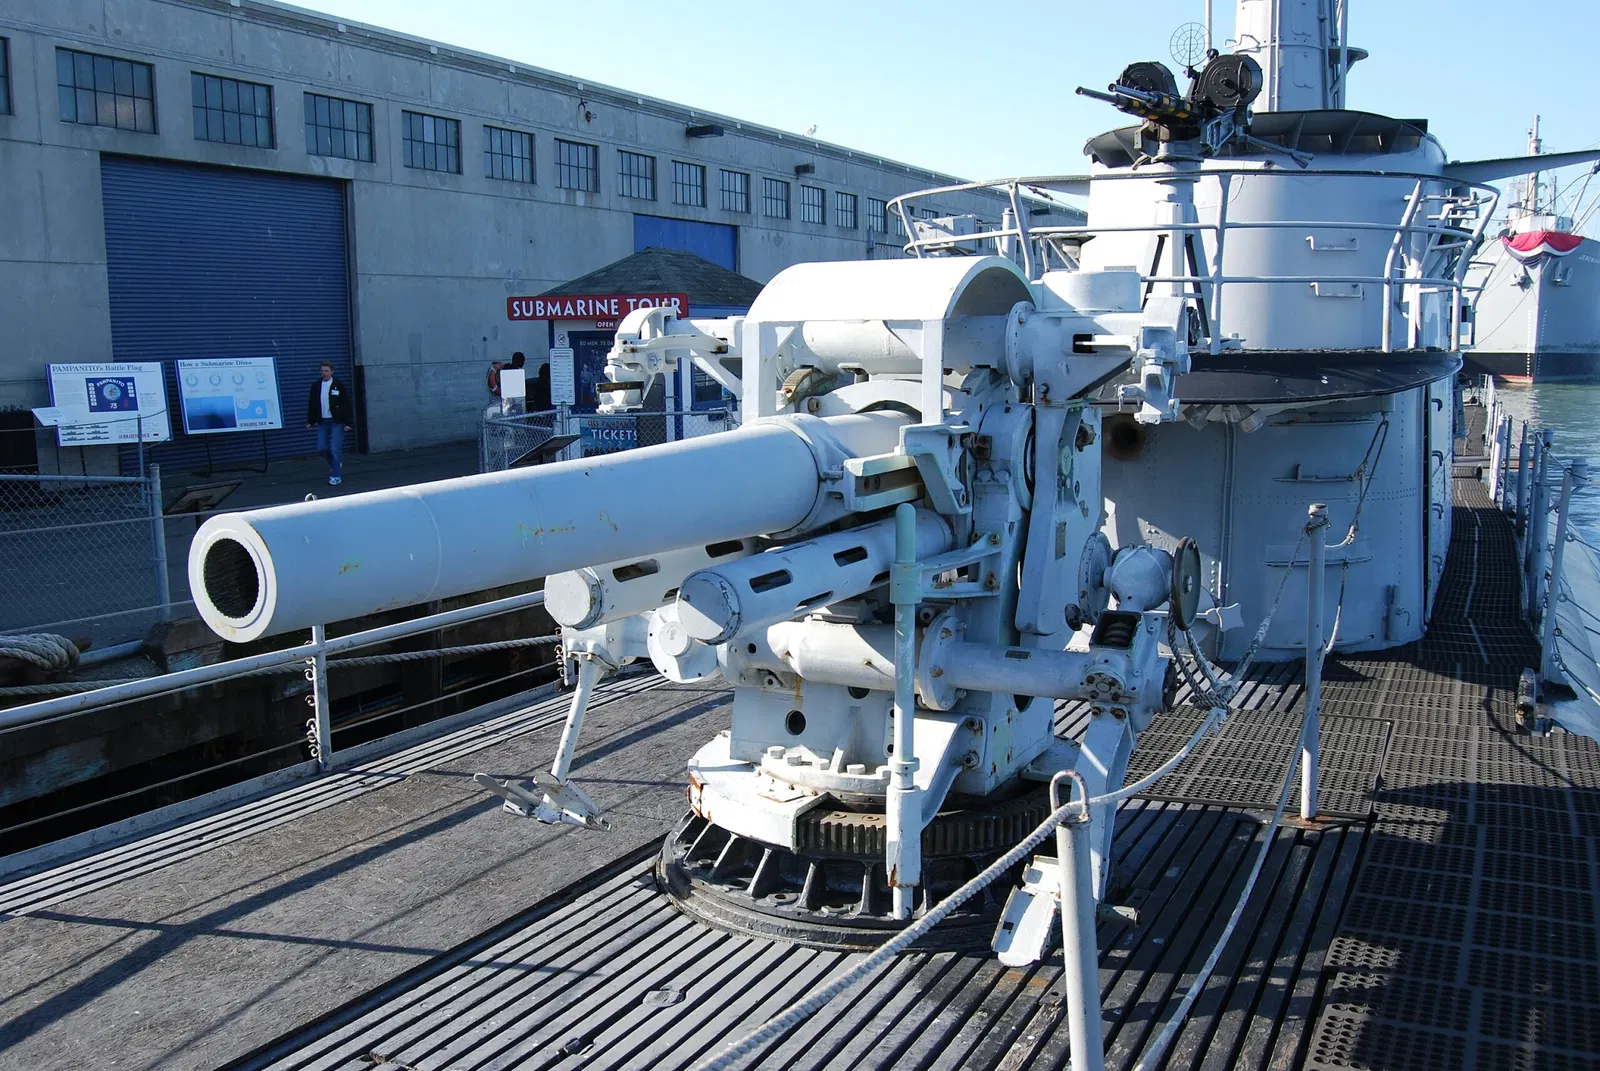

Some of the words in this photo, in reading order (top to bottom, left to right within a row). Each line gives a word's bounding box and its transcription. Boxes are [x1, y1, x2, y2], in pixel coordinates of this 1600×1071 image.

[512, 298, 619, 317] SUBMARINE
[52, 364, 104, 373] PAMPANITO's
[105, 363, 126, 371] Battle
[127, 363, 143, 372] Flag
[201, 360, 233, 368] Submarine
[96, 379, 126, 388] PAMPANITO
[591, 429, 638, 441] TICKETS
